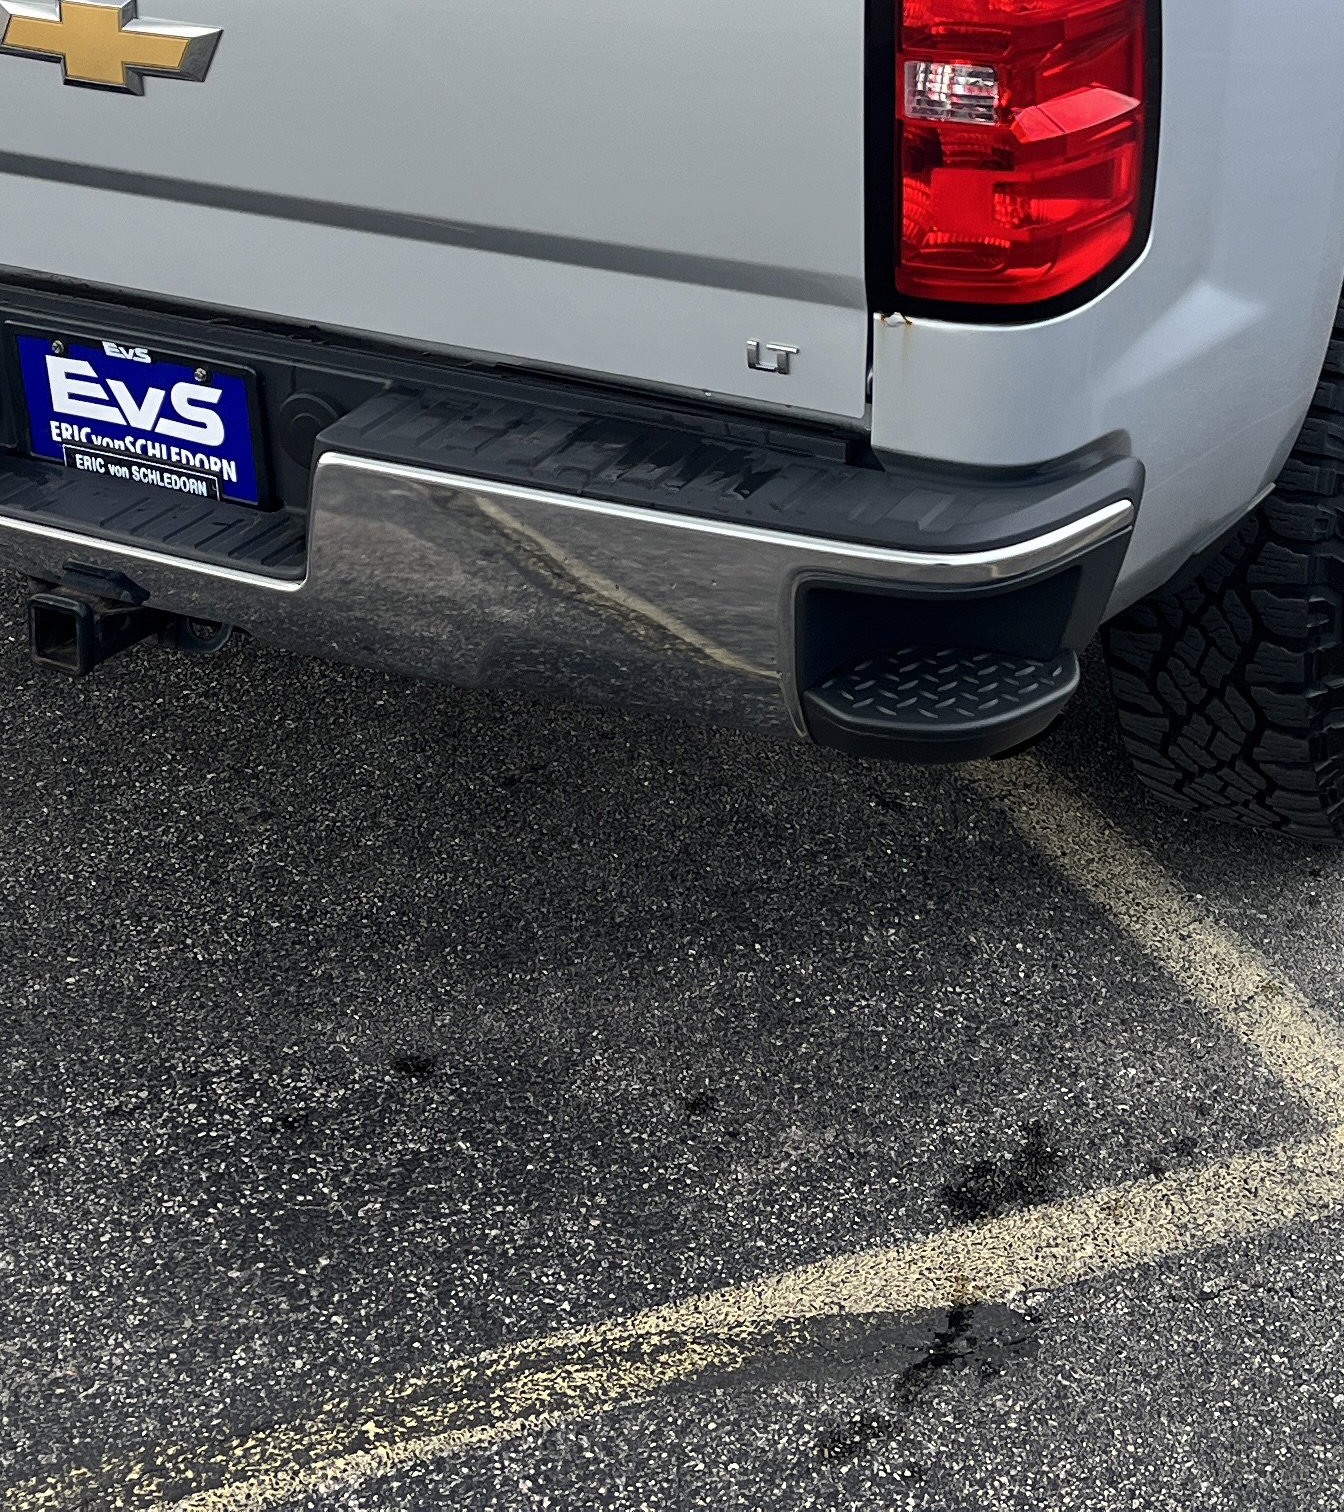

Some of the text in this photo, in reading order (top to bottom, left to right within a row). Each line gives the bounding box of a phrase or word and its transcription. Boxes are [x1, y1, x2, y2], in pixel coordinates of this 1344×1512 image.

[746, 340, 800, 375] LT
[75, 454, 208, 497] ERIC von SCHLEDORN
